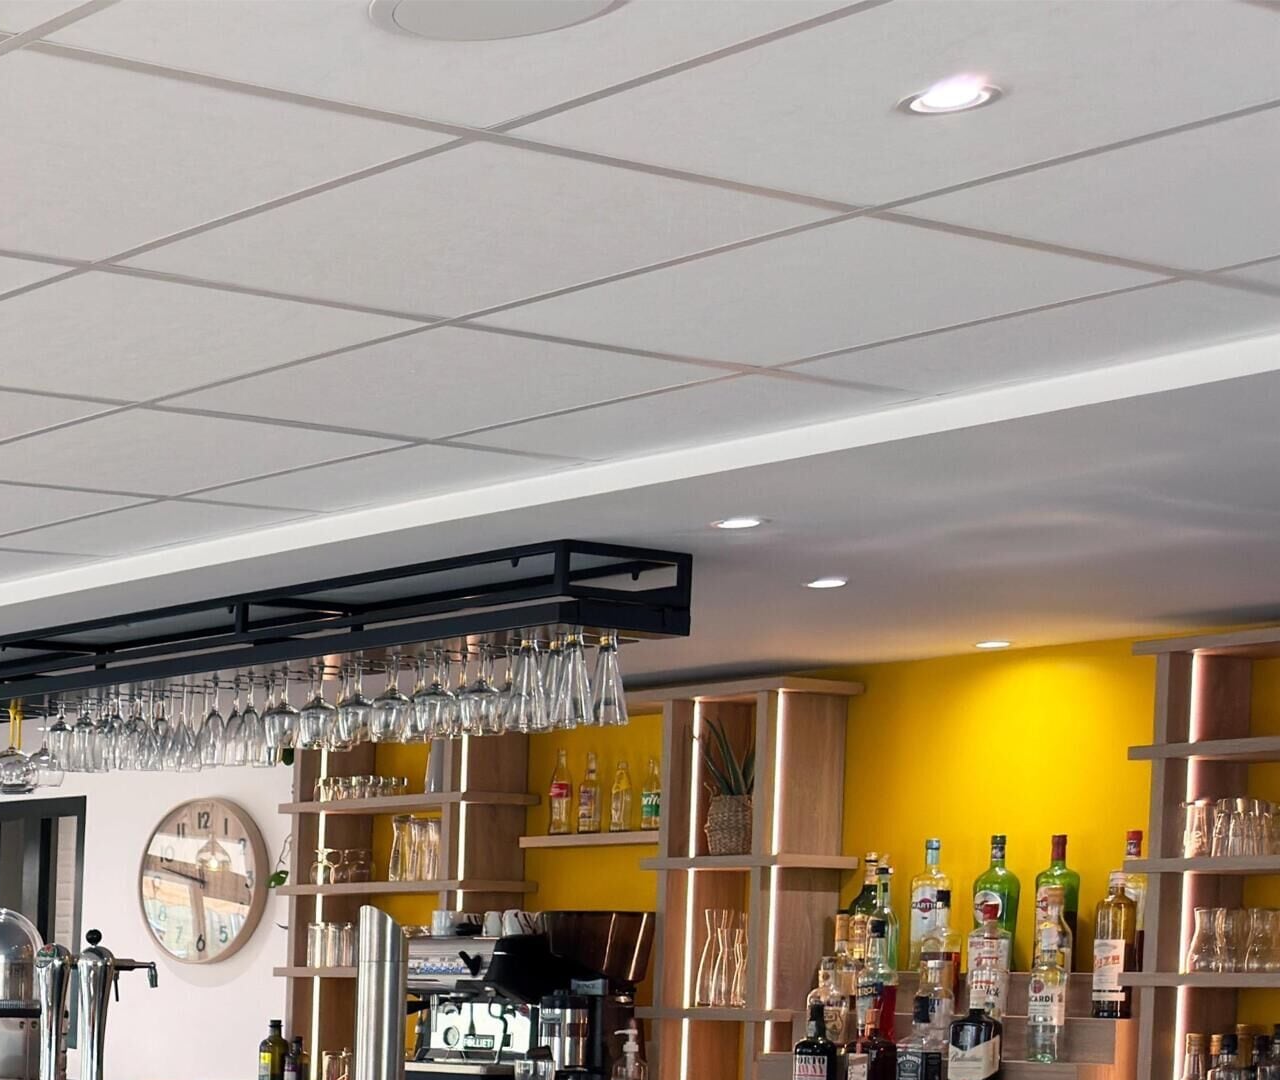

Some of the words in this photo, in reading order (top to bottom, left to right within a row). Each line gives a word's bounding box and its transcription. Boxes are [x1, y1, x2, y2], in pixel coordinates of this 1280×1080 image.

[198, 811, 210, 829] 12
[224, 817, 228, 836] 1
[176, 822, 185, 838] 11
[160, 845, 175, 863] 10
[244, 870, 254, 889] 3
[219, 925, 228, 943] 5
[196, 934, 206, 953] 6
